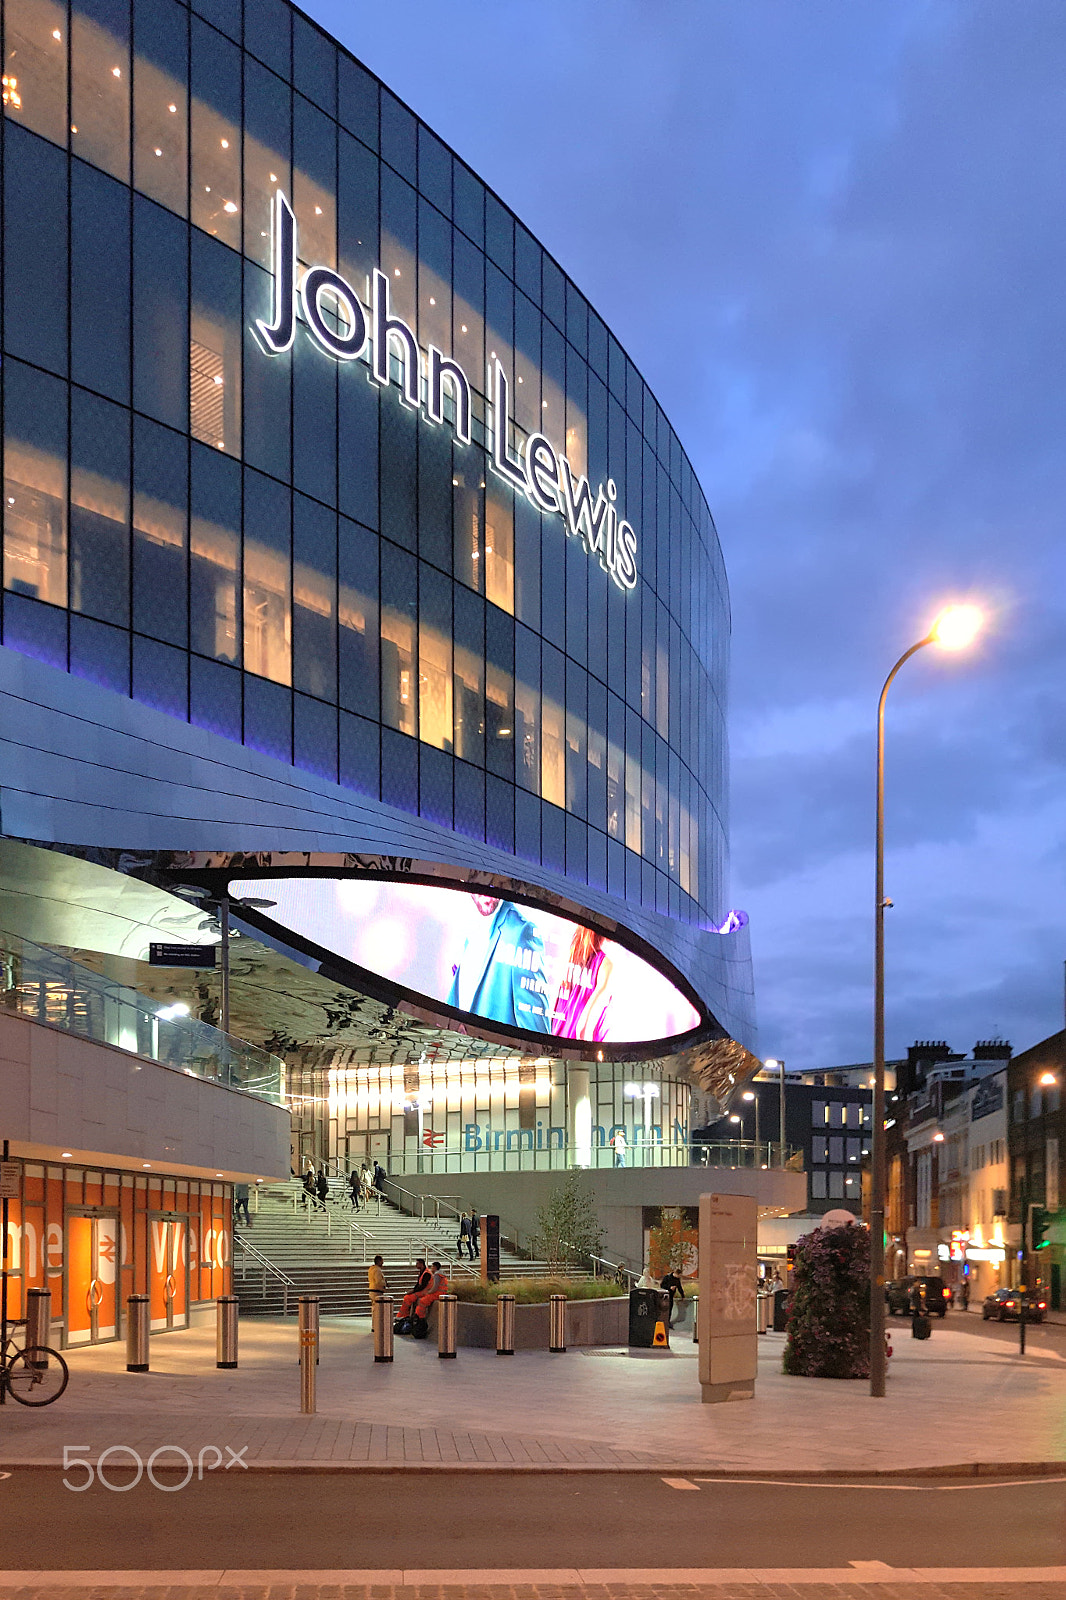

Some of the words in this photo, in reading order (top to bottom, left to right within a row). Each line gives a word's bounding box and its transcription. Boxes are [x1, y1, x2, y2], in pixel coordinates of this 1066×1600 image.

[252, 188, 472, 446] John
[492, 357, 638, 590] Lewis
[465, 1117, 662, 1152] Birminham
